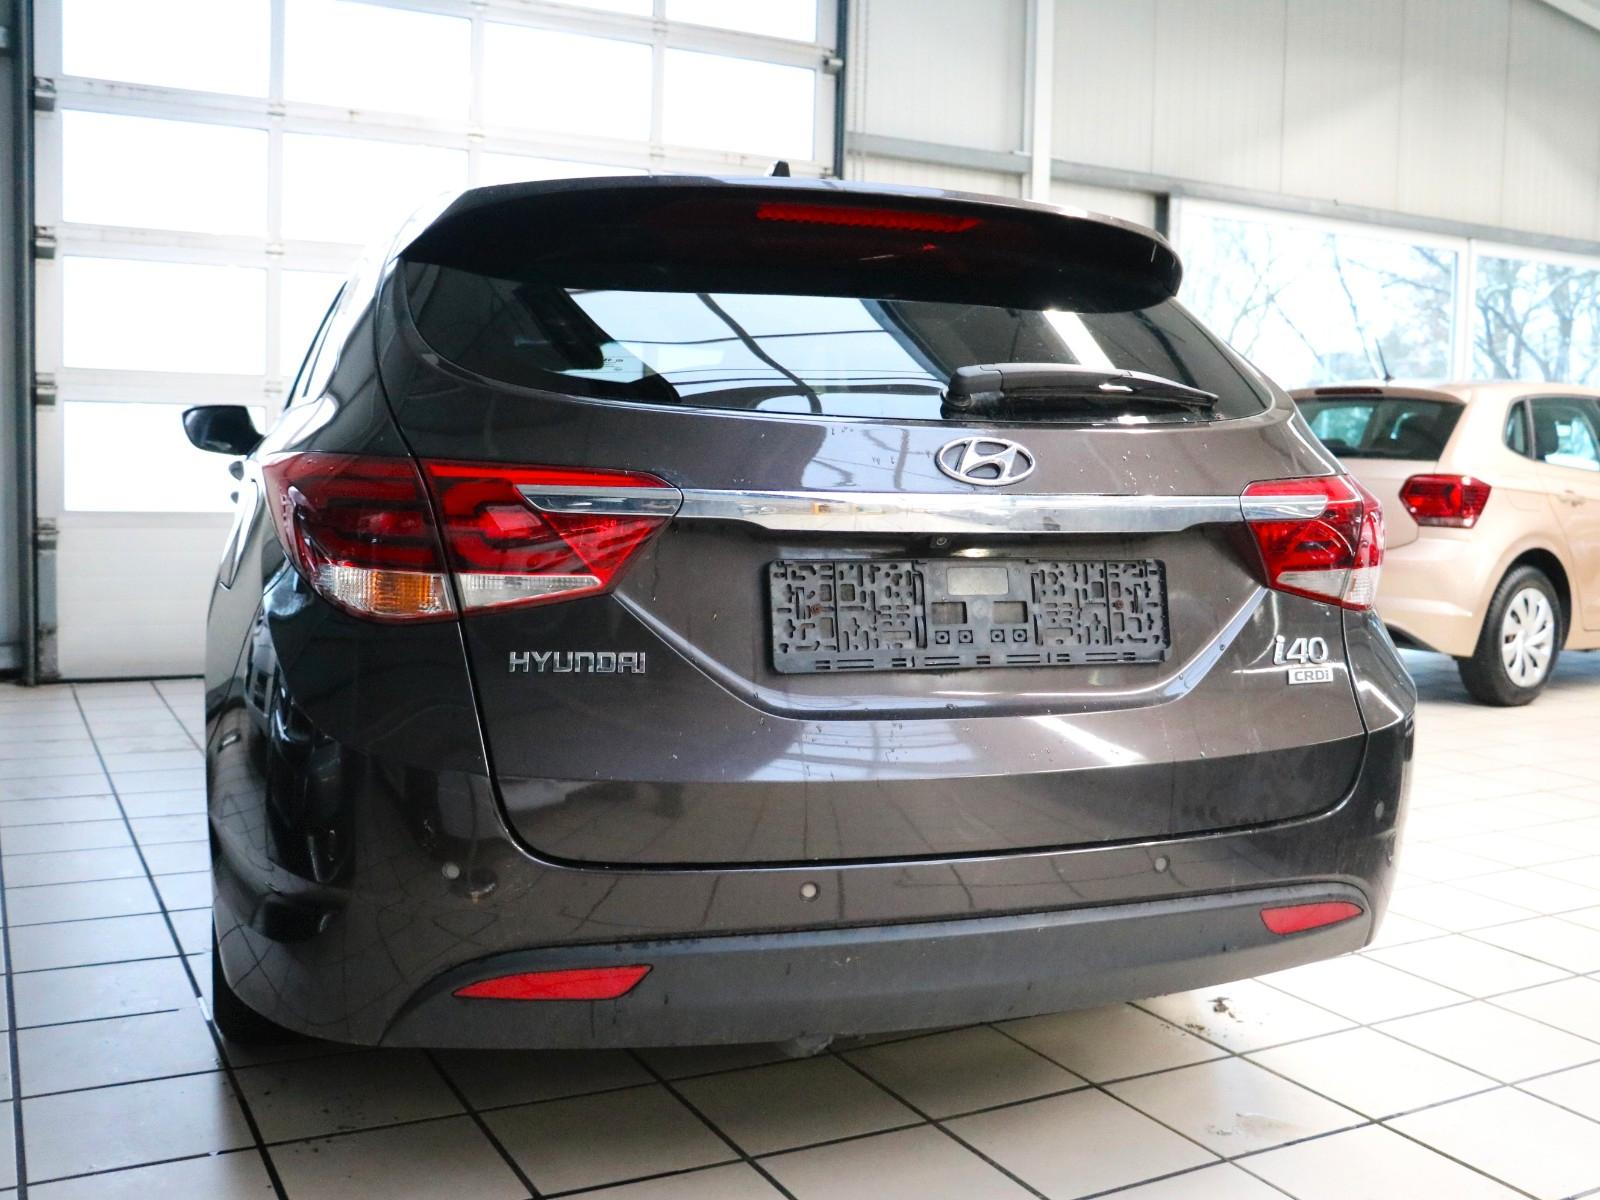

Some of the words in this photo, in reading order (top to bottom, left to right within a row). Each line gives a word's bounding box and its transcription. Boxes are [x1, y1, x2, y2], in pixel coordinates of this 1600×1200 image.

[1274, 635, 1328, 665] i40
[509, 651, 646, 673] HYUNDAI
[1294, 670, 1330, 682] CRDi
